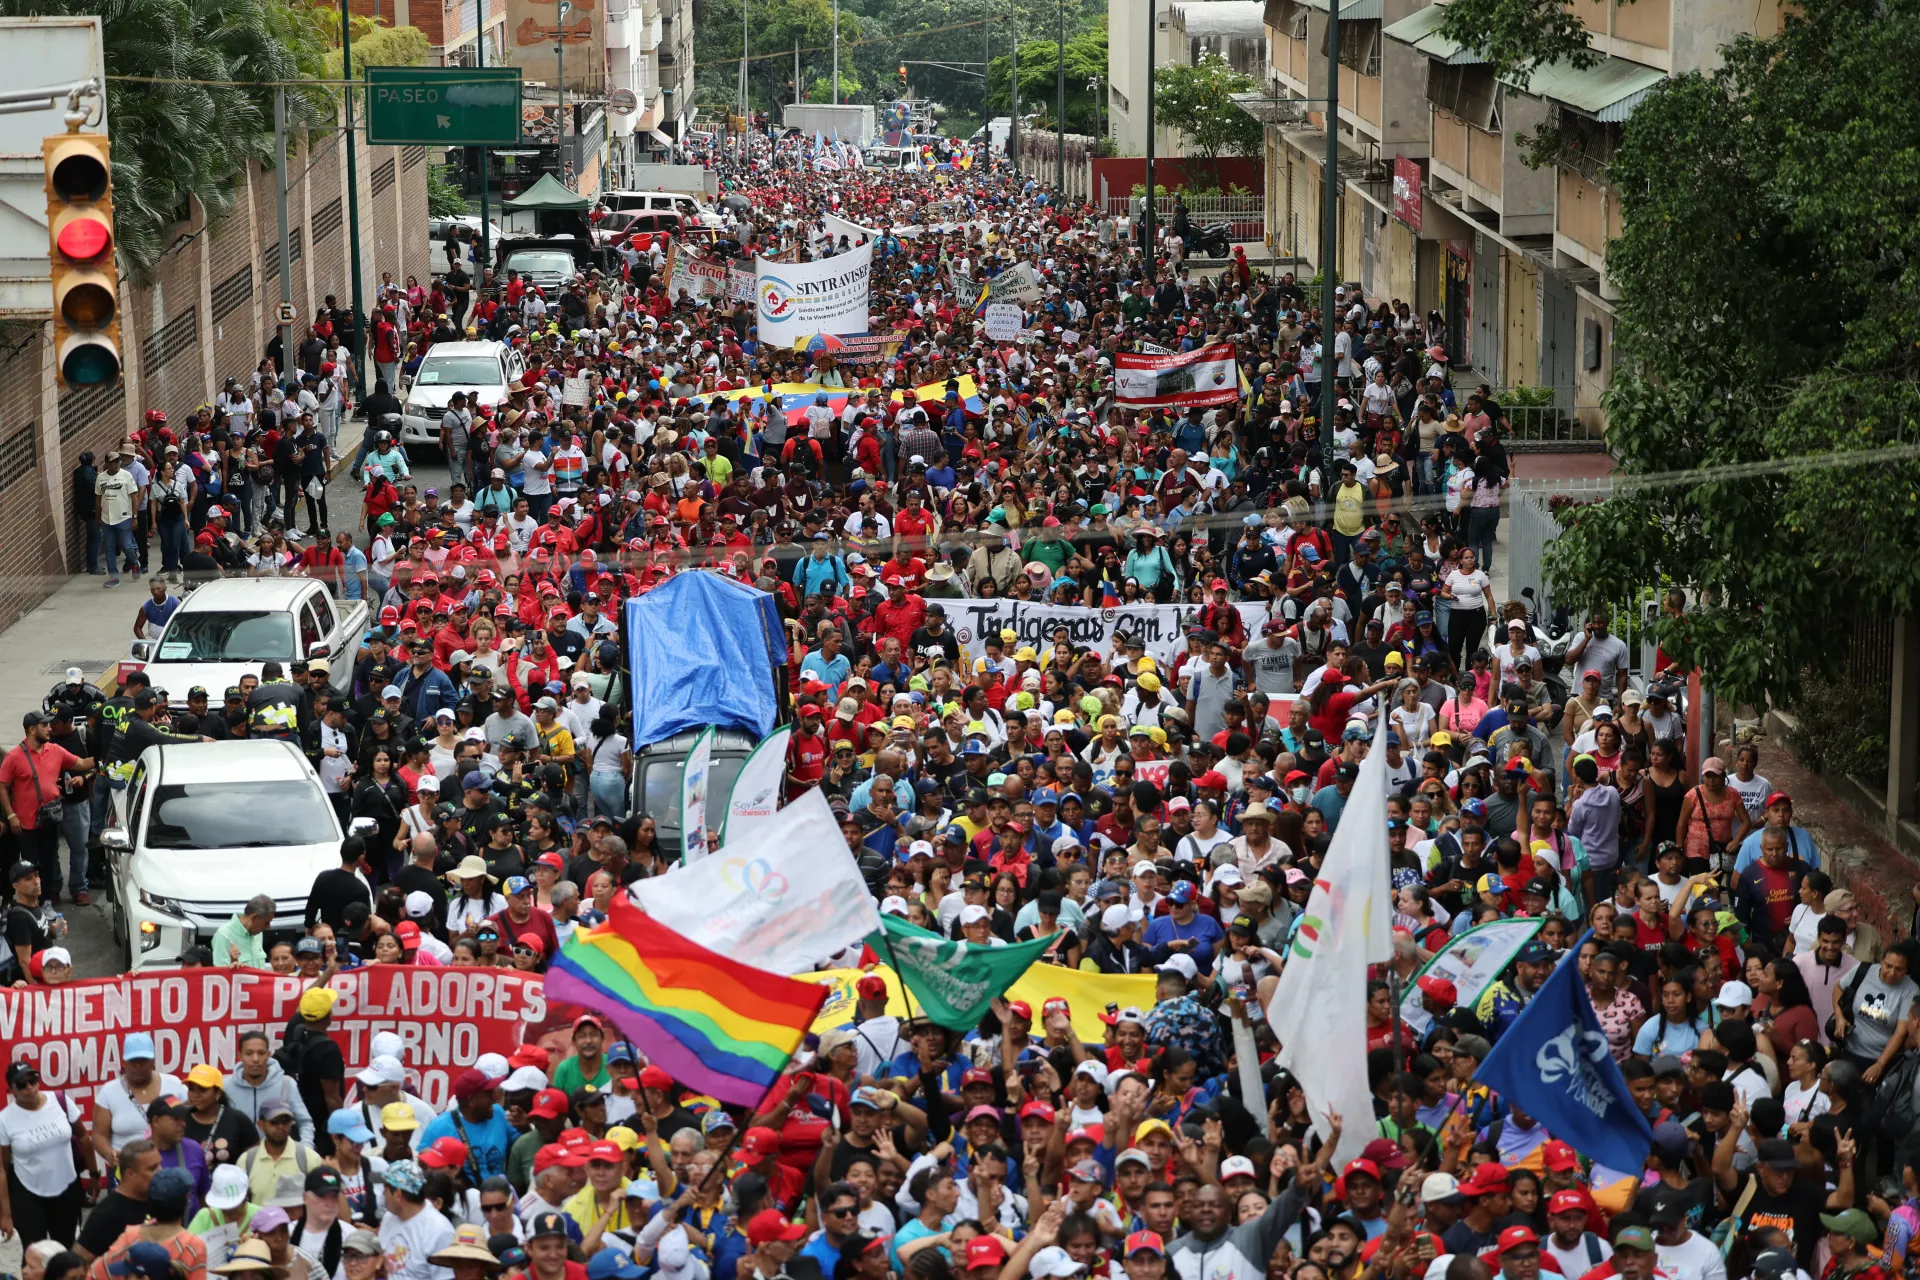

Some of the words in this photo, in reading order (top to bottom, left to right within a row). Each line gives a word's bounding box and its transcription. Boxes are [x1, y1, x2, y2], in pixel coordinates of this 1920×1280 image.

[377, 88, 439, 103] PASEO
[796, 263, 869, 296] SINTRAVISEP
[825, 300, 847, 311] Nacional
[281, 306, 292, 320] E
[813, 312, 837, 321] Vivienda
[848, 335, 906, 345] EMPRENDEDORES
[840, 344, 879, 353] URBANISMO
[1261, 654, 1289, 665] YANKEES
[1769, 887, 1789, 897] Qatar
[202, 973, 260, 1023] DE
[272, 970, 548, 1024] PBLADORES
[11, 1020, 290, 1087] COMADANE
[326, 1019, 480, 1067] TRNO
[28, 1121, 59, 1136] YOUR
